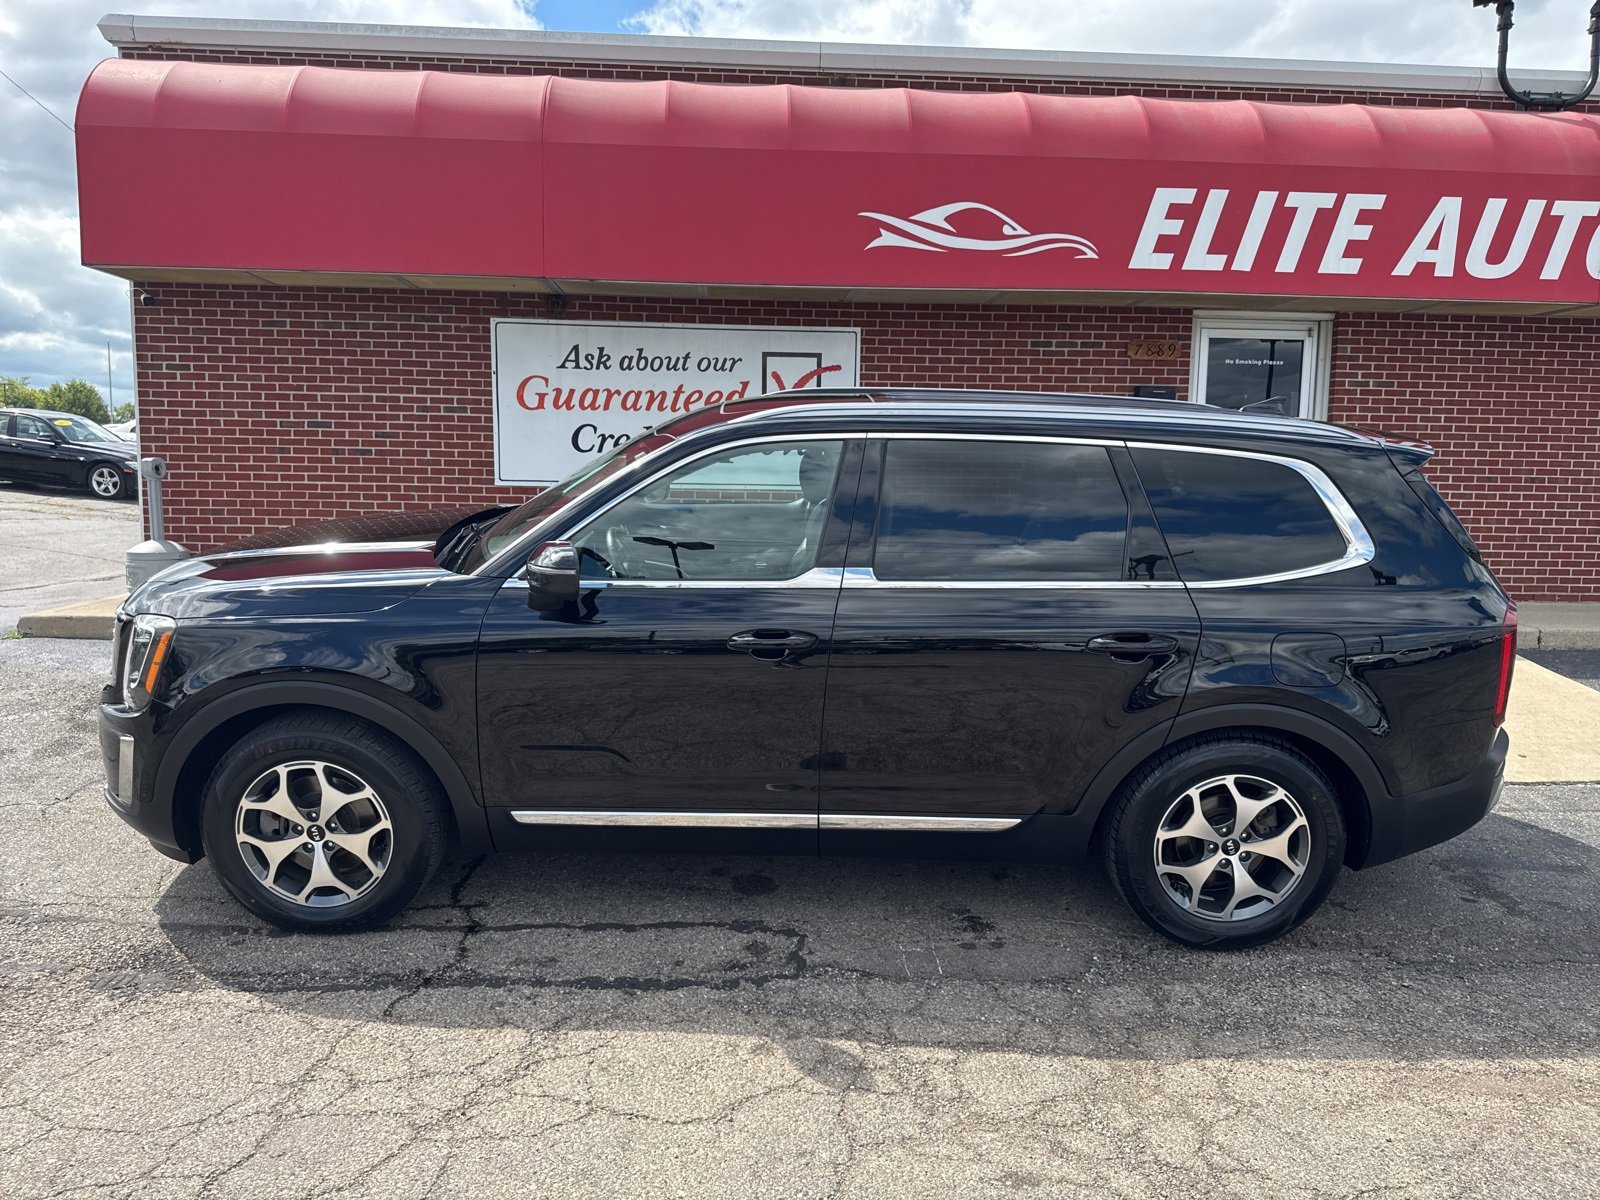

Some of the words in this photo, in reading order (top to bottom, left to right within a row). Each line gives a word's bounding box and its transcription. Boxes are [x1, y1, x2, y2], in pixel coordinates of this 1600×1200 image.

[1128, 187, 1387, 274] ELITE
[556, 343, 612, 371] Ask
[619, 347, 691, 372] about
[697, 355, 742, 373] our
[1134, 343, 1177, 358] 7889
[1235, 358, 1262, 367] Smoking
[515, 374, 751, 414] Guaranteed
[310, 825, 321, 841] KIA
[1226, 839, 1236, 855] KIA
